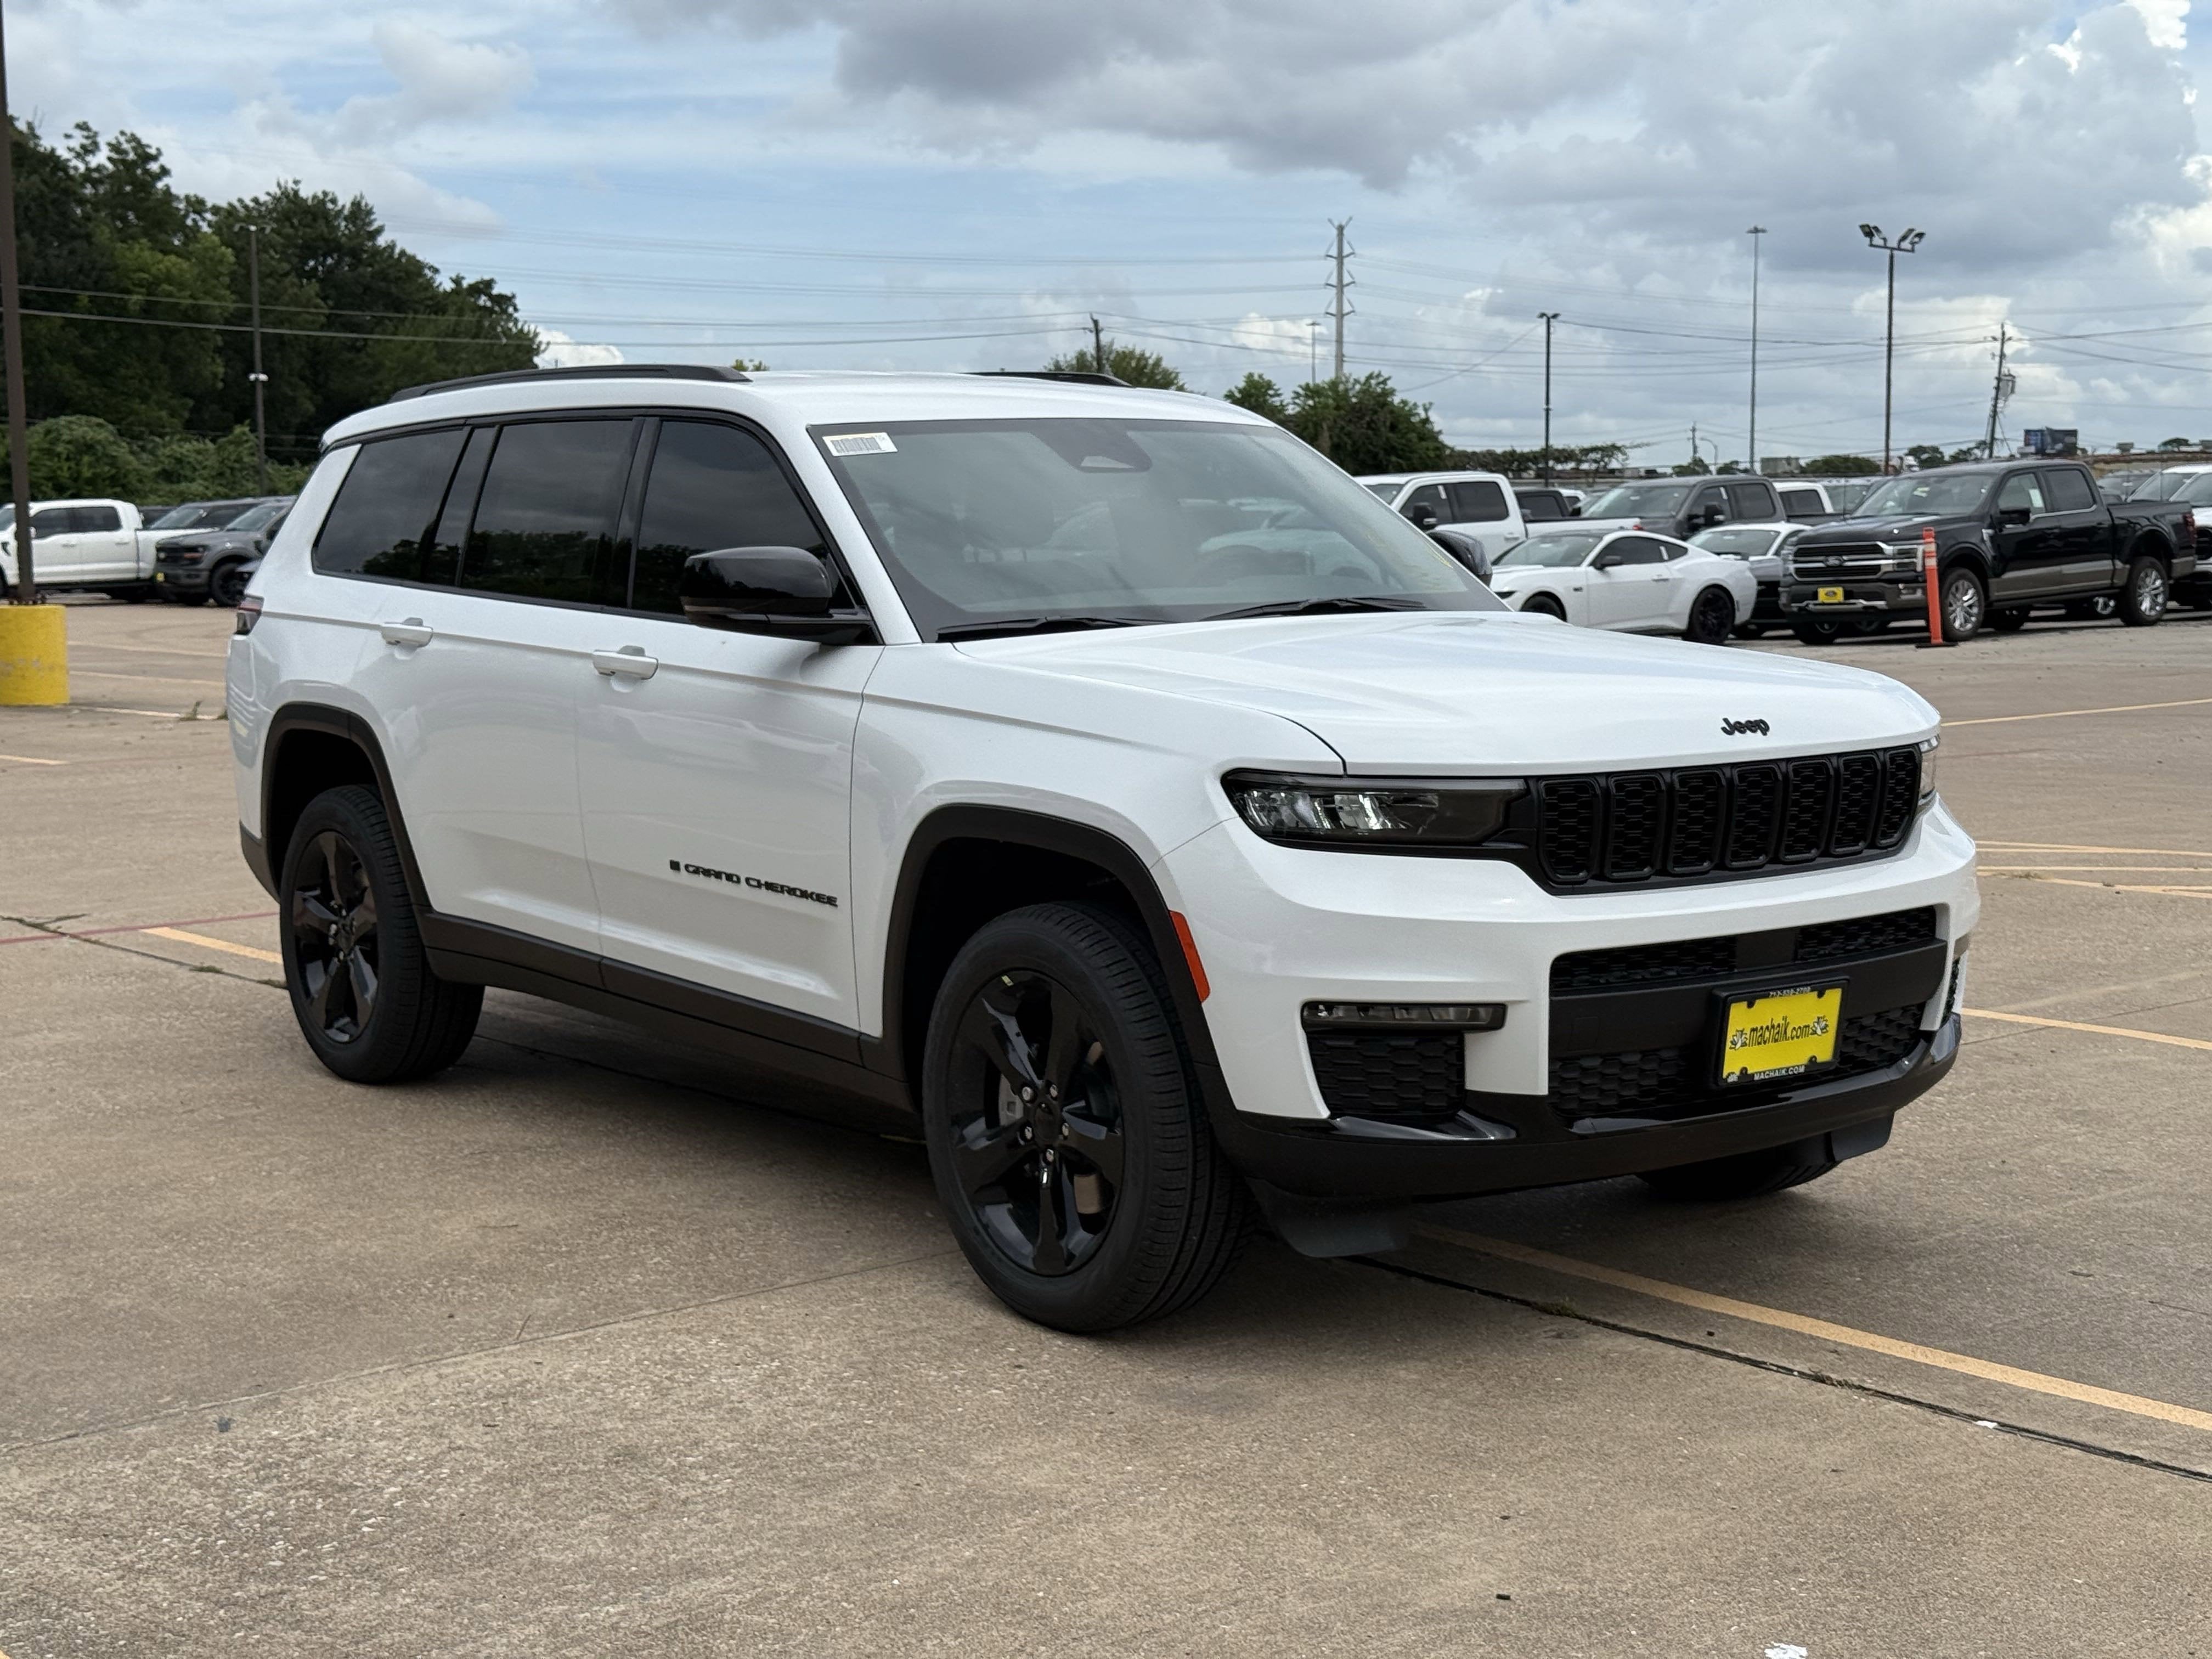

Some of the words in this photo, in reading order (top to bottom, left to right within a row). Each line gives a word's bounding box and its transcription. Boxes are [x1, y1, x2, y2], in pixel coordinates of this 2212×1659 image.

[1720, 718, 1770, 736] Jeep
[684, 864, 741, 884] GRAND
[745, 877, 838, 907] CHEROKEE
[1748, 1015, 1810, 1047] machaik.com
[1753, 1065, 1805, 1080] MACHAIK.COM
